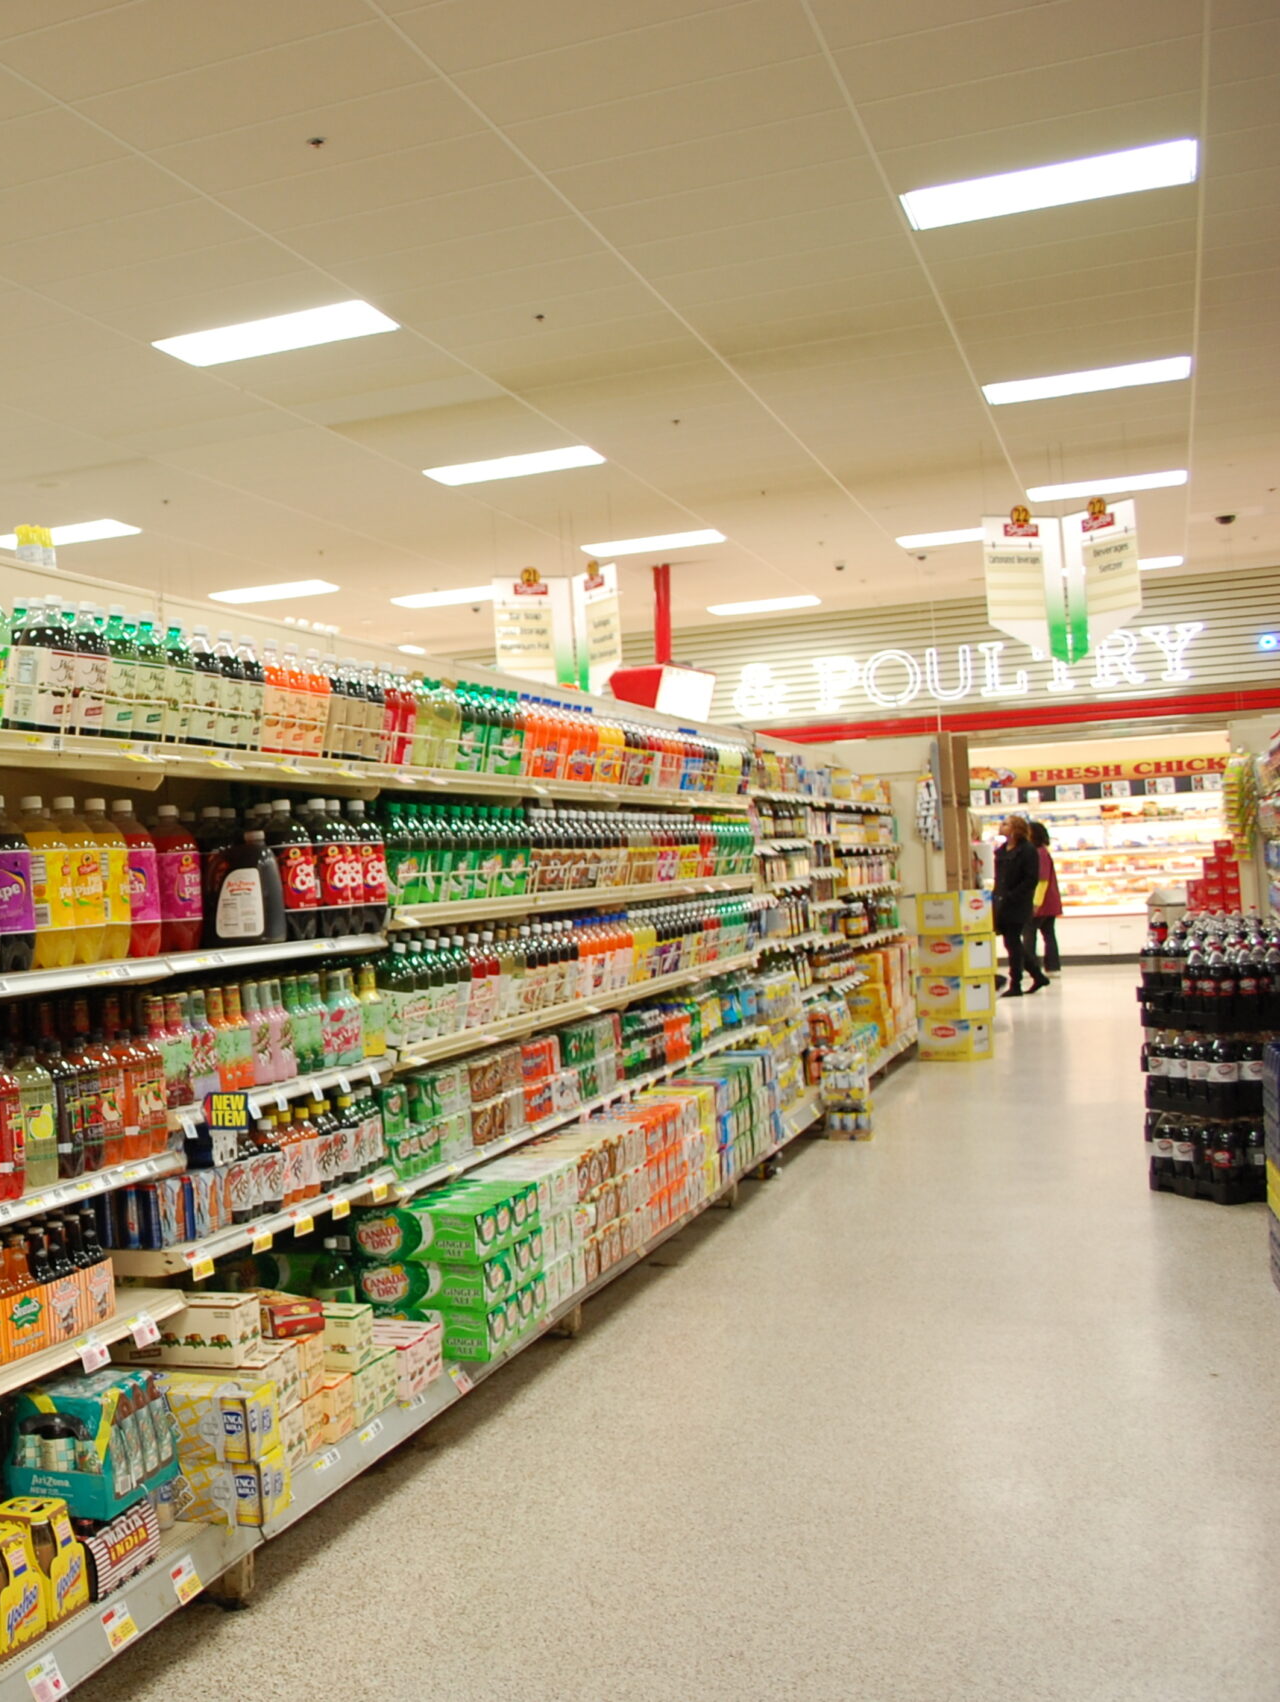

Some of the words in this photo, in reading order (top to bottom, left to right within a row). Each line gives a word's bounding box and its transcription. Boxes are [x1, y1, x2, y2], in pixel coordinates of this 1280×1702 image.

[1011, 507, 1029, 522] 22
[1093, 542, 1129, 558] Beverages
[1099, 561, 1123, 573] Seltzer
[526, 570, 536, 583] 21
[1029, 763, 1122, 783] FRESH
[1133, 756, 1228, 776] CHICK
[211, 1094, 246, 1111] NEW
[211, 1110, 247, 1127] ITEM
[357, 1225, 400, 1245] CANADA
[371, 1238, 393, 1251] DRY
[435, 1240, 472, 1249] GINGER
[445, 1249, 464, 1257] ALE
[362, 1274, 408, 1293] CANADA
[376, 1286, 399, 1298] DRY
[443, 1287, 481, 1296] GINGER
[453, 1296, 471, 1305] ALE
[446, 1338, 483, 1347] GINGER
[455, 1346, 474, 1355] ALE
[223, 1411, 242, 1422] INCA
[31, 1474, 71, 1489] AriZona
[235, 1475, 255, 1486] INCA
[102, 1514, 144, 1547] MALTA
